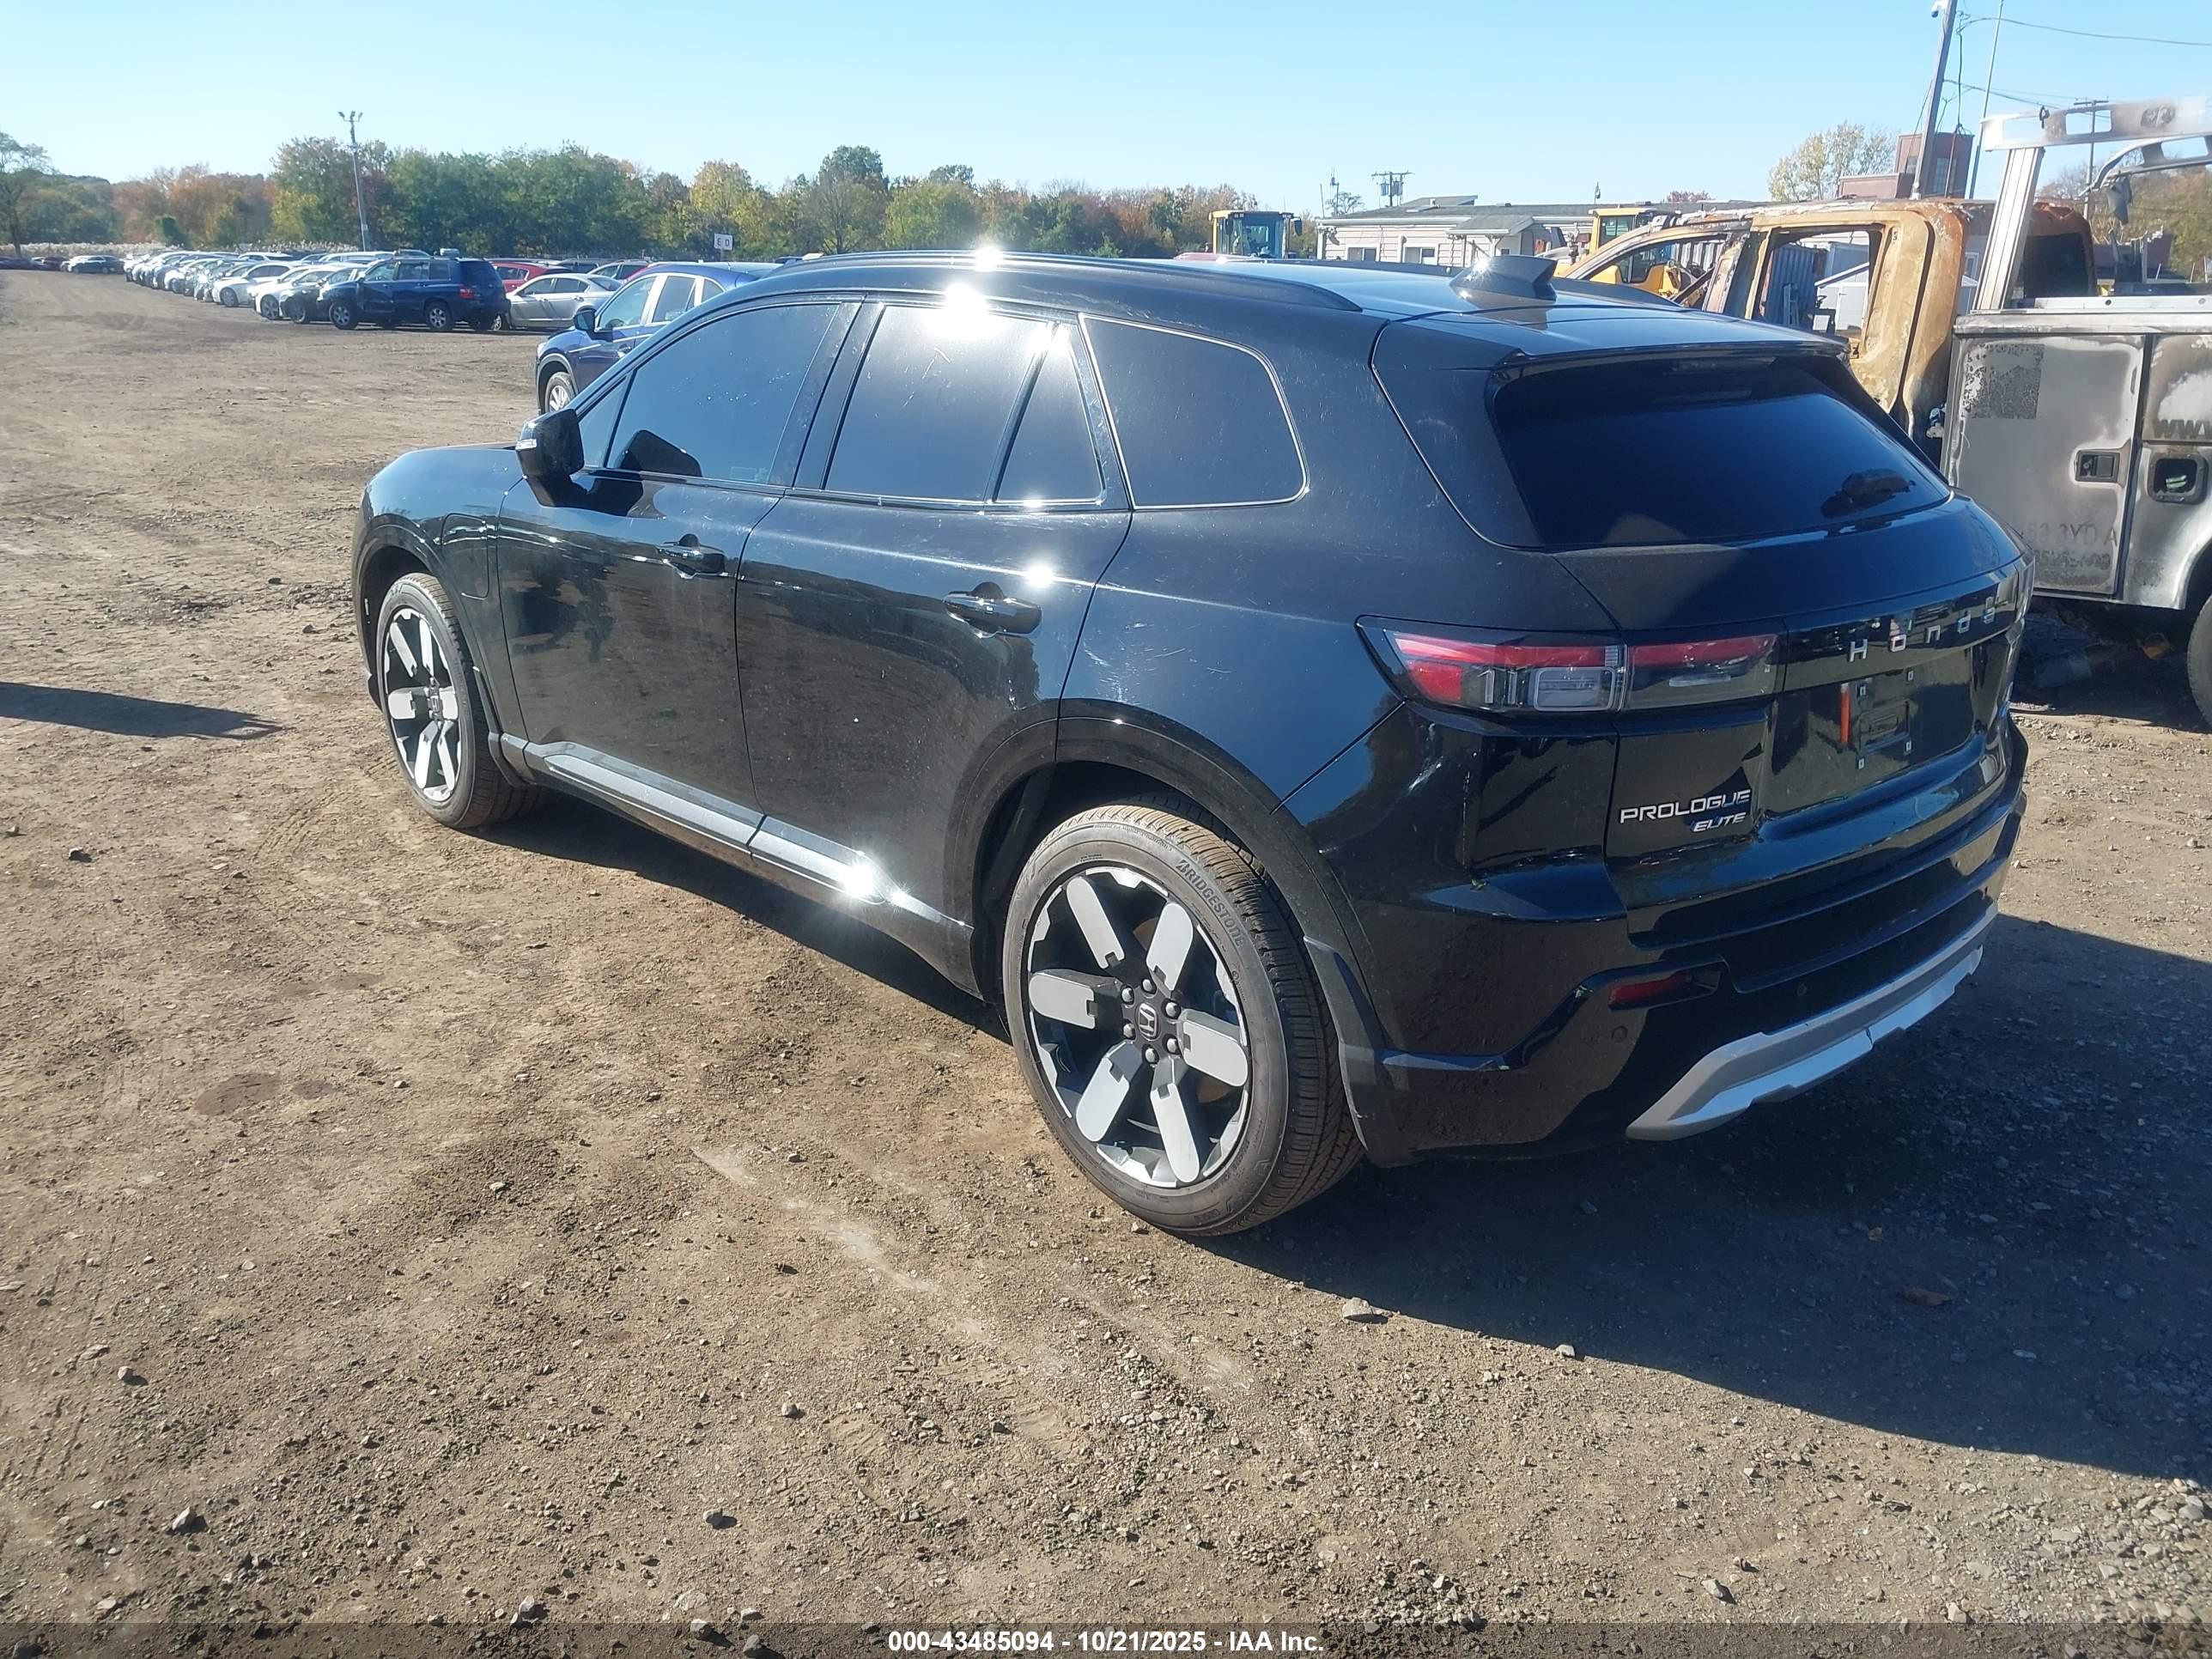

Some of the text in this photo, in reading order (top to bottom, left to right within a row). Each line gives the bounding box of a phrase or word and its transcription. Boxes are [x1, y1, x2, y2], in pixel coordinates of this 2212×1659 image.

[1620, 788, 1751, 824] PROLOGUE
[1692, 811, 1747, 833] ELITE
[1175, 859, 1244, 947] BRIDGESTONE
